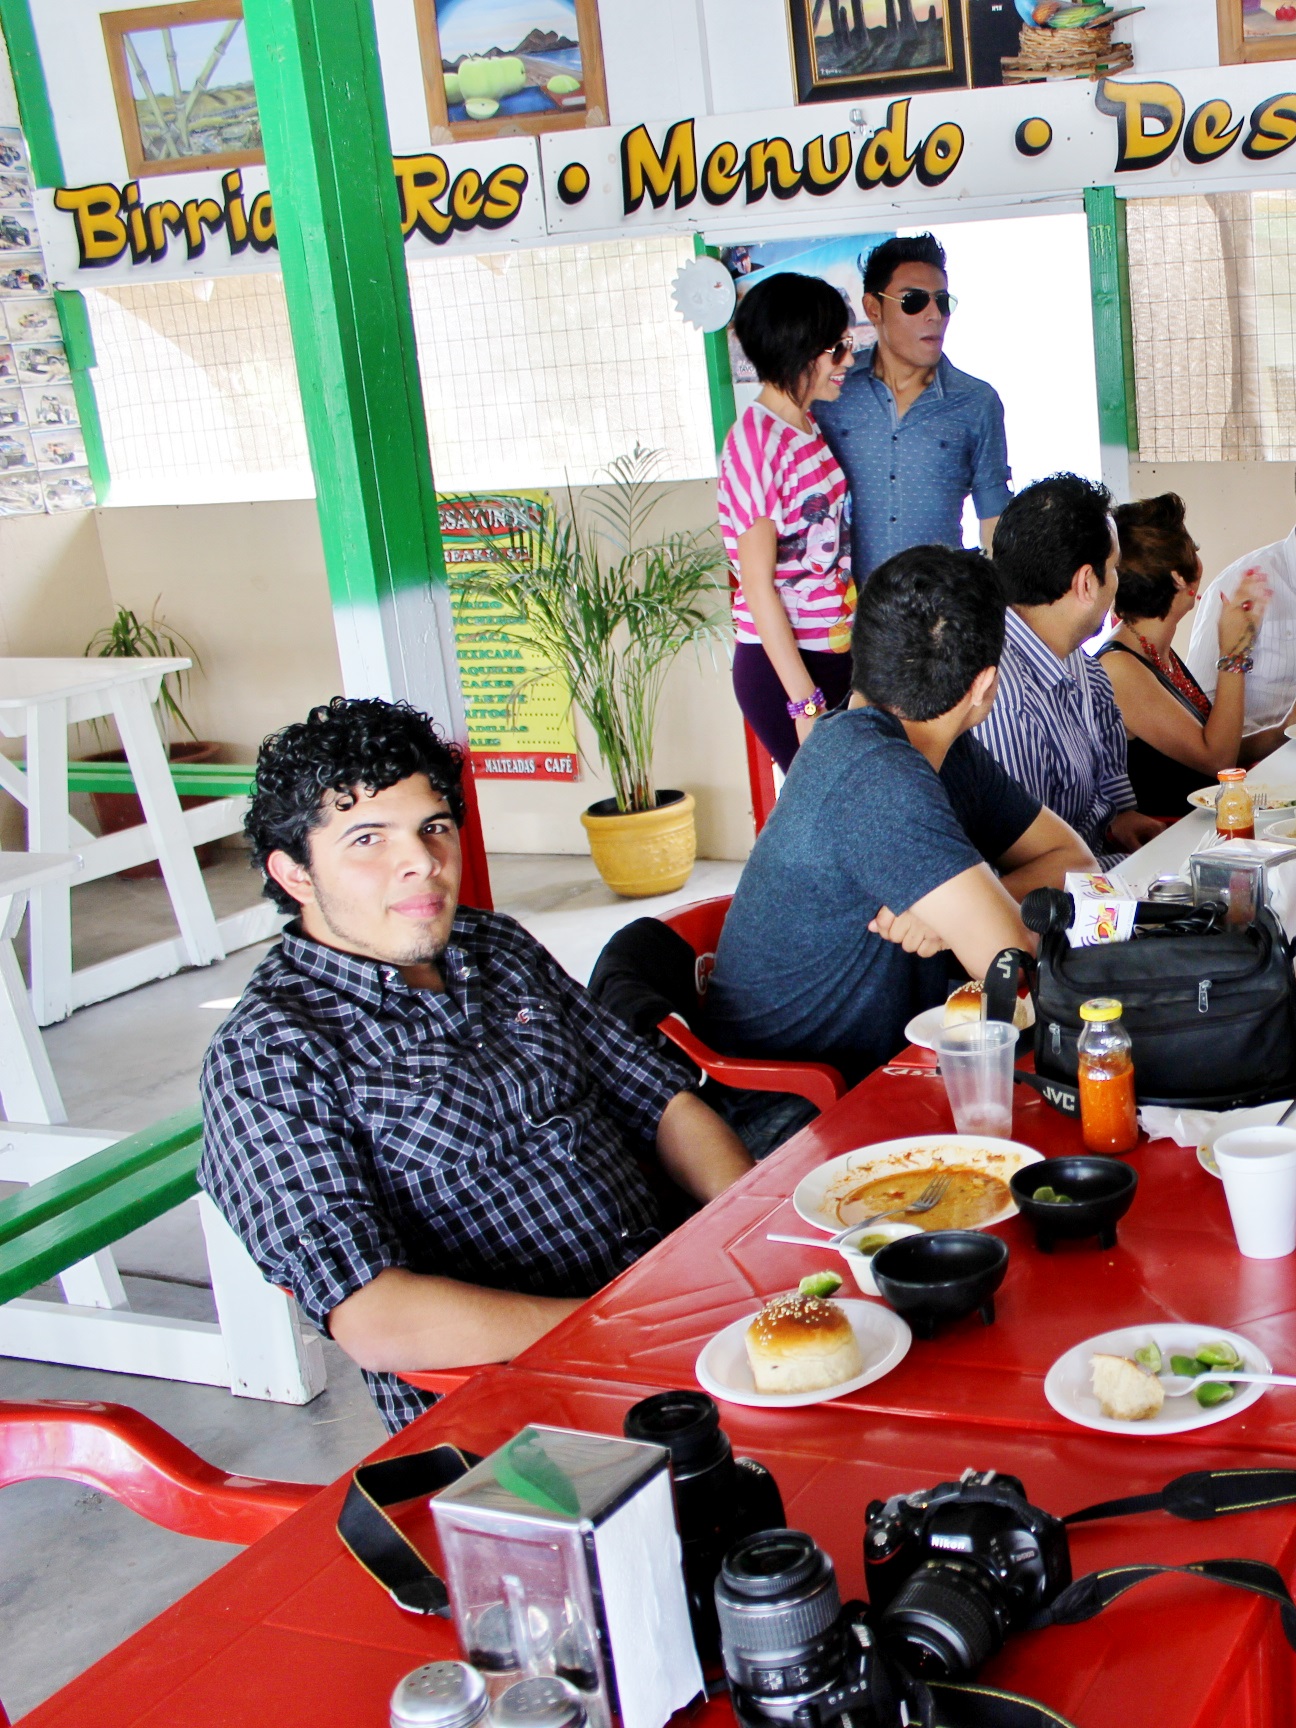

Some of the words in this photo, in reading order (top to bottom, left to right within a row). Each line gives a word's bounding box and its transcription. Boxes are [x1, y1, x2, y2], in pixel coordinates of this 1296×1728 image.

[390, 153, 529, 245] Res
[620, 97, 965, 216] Menudo
[470, 738, 501, 747] ALES
[484, 758, 535, 774] MALTEADAS
[544, 755, 574, 774] CAFÉ
[996, 949, 1020, 979] JV
[1042, 1085, 1076, 1112] JVC
[931, 1535, 966, 1550] Nikon
